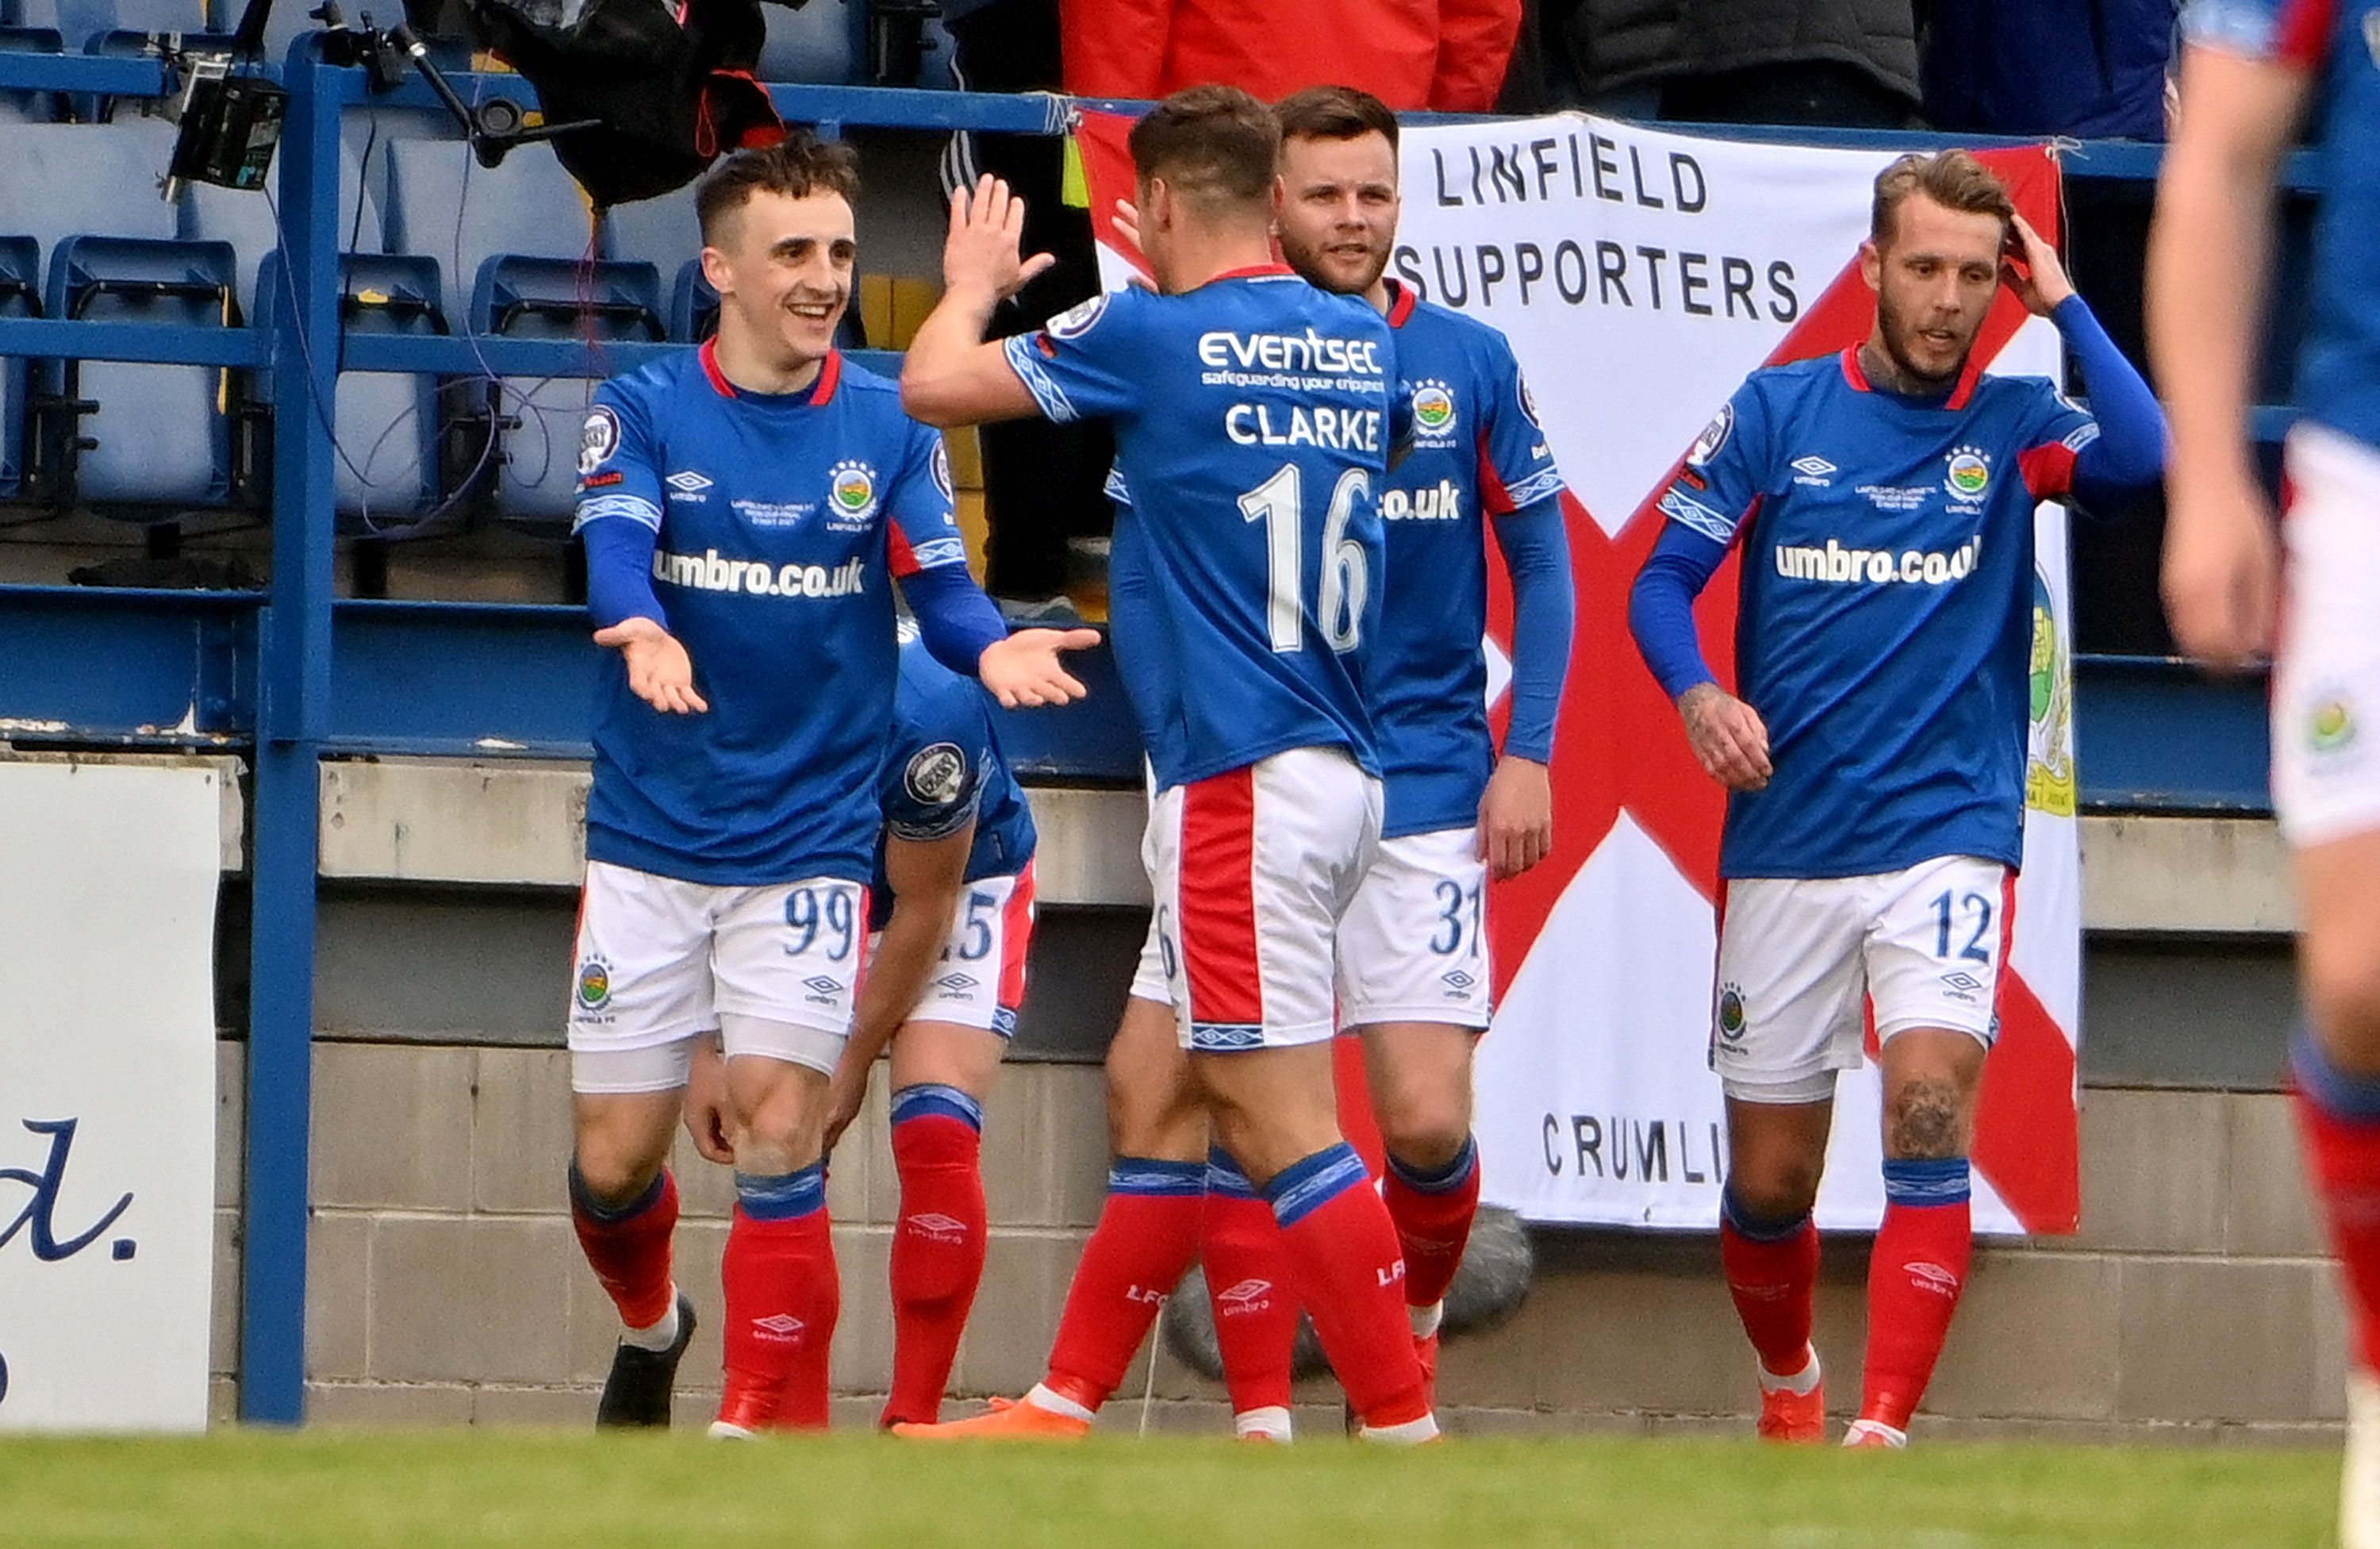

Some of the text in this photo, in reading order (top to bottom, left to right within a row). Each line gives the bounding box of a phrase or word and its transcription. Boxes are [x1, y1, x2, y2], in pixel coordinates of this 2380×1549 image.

[1432, 133, 1706, 213] LINFIELD
[1394, 240, 1798, 323] SUPPORTERS
[1226, 404, 1381, 452] CLARKE
[653, 549, 866, 598] umbro.co.uk
[1237, 463, 1369, 653] 16
[783, 886, 854, 963] 99
[1430, 880, 1481, 959] 31
[1929, 888, 1992, 964] 12
